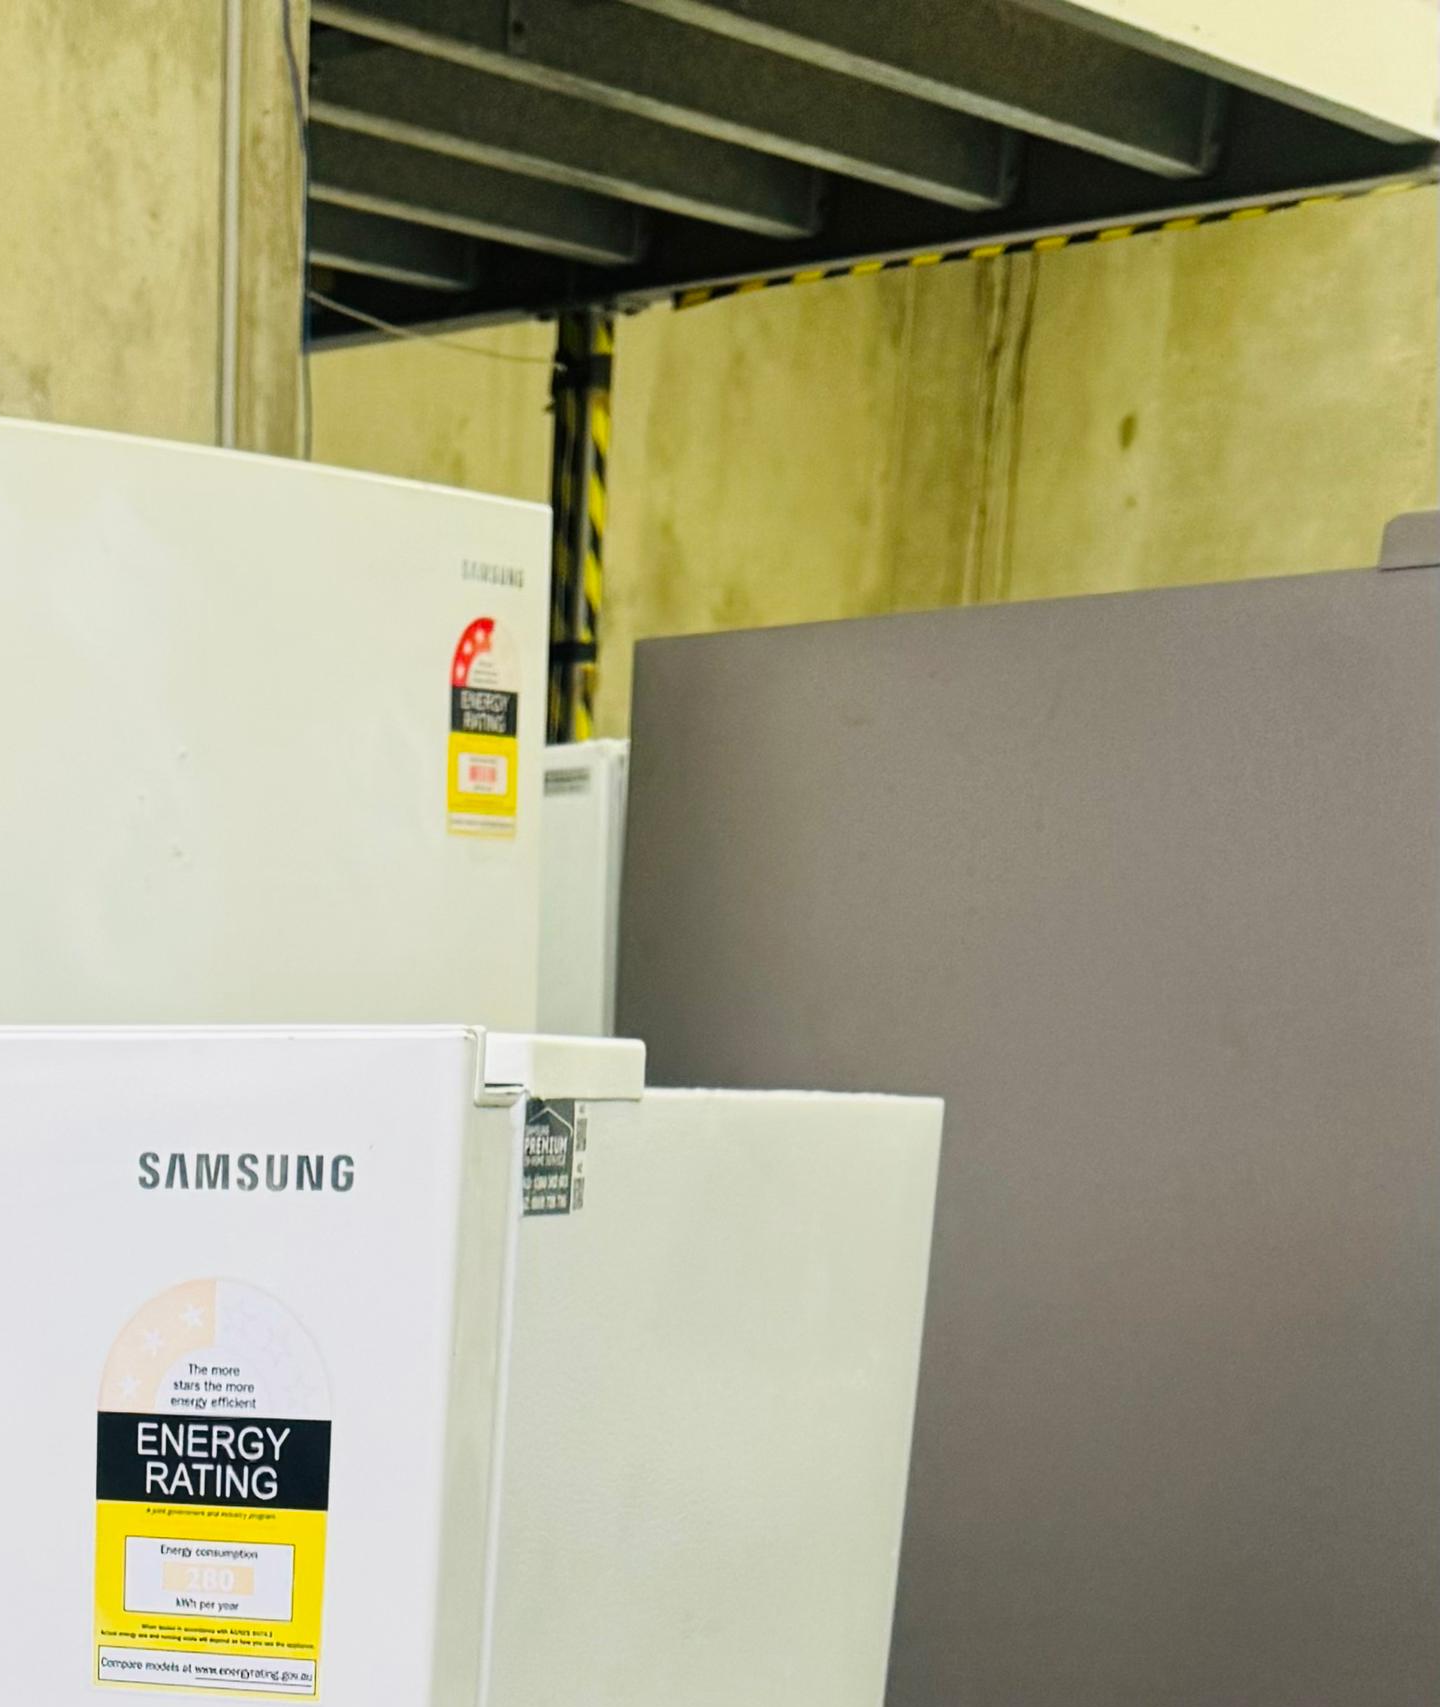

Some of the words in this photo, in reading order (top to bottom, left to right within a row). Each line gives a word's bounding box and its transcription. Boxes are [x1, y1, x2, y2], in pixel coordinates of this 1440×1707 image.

[462, 559, 523, 588] SAMSUNG
[461, 690, 511, 712] ENERGY
[138, 1152, 355, 1193] SAMSUNG
[189, 1363, 208, 1376] The
[211, 1366, 240, 1377] more
[173, 1380, 201, 1392] stars
[204, 1380, 222, 1392] the
[225, 1383, 255, 1393] more
[170, 1397, 207, 1410] energy
[211, 1397, 257, 1410] efficient
[137, 1422, 291, 1462] ENERGY
[145, 1461, 278, 1500] RATING
[160, 1544, 192, 1558] Energy
[195, 1547, 258, 1560] consumption
[199, 1600, 215, 1612] per
[217, 1601, 240, 1612] year
[101, 1656, 143, 1670] Compare
[145, 1661, 179, 1673] models
[194, 1665, 313, 1682] www.energyrating.gov.au
